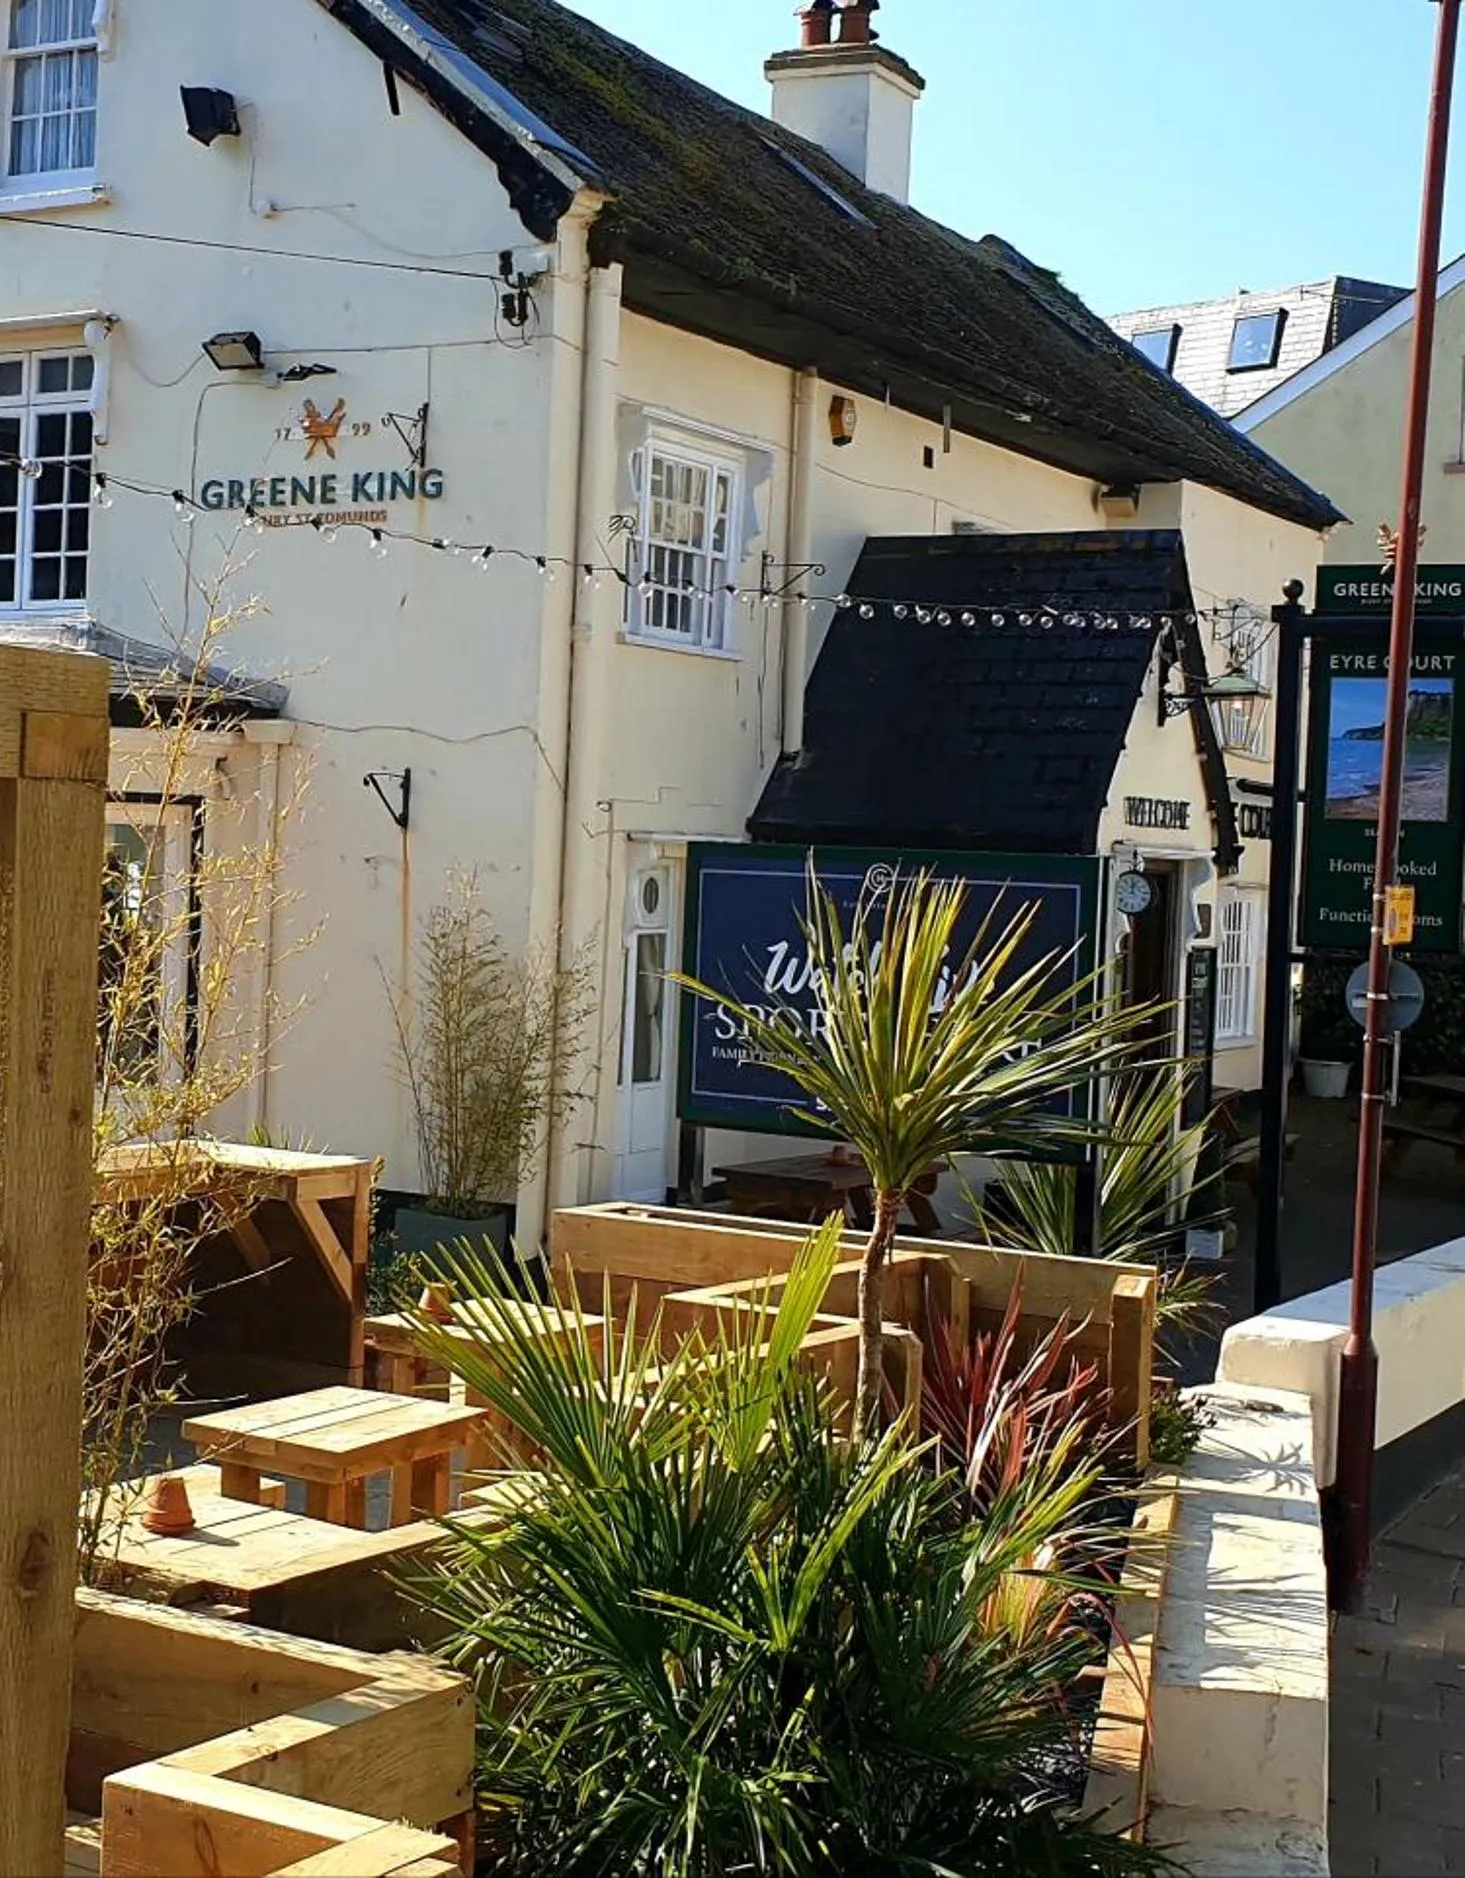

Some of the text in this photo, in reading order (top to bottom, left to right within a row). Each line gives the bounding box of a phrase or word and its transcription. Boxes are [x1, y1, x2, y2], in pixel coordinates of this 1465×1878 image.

[201, 468, 444, 510] GREENE KING
[1333, 583, 1462, 597] GREEN KING
[1329, 655, 1455, 671] EYRE CURT
[1123, 796, 1191, 830] WELCOME
[1240, 804, 1272, 839] COUR
[1329, 859, 1437, 876] Home oked
[1319, 907, 1374, 923] Functi
